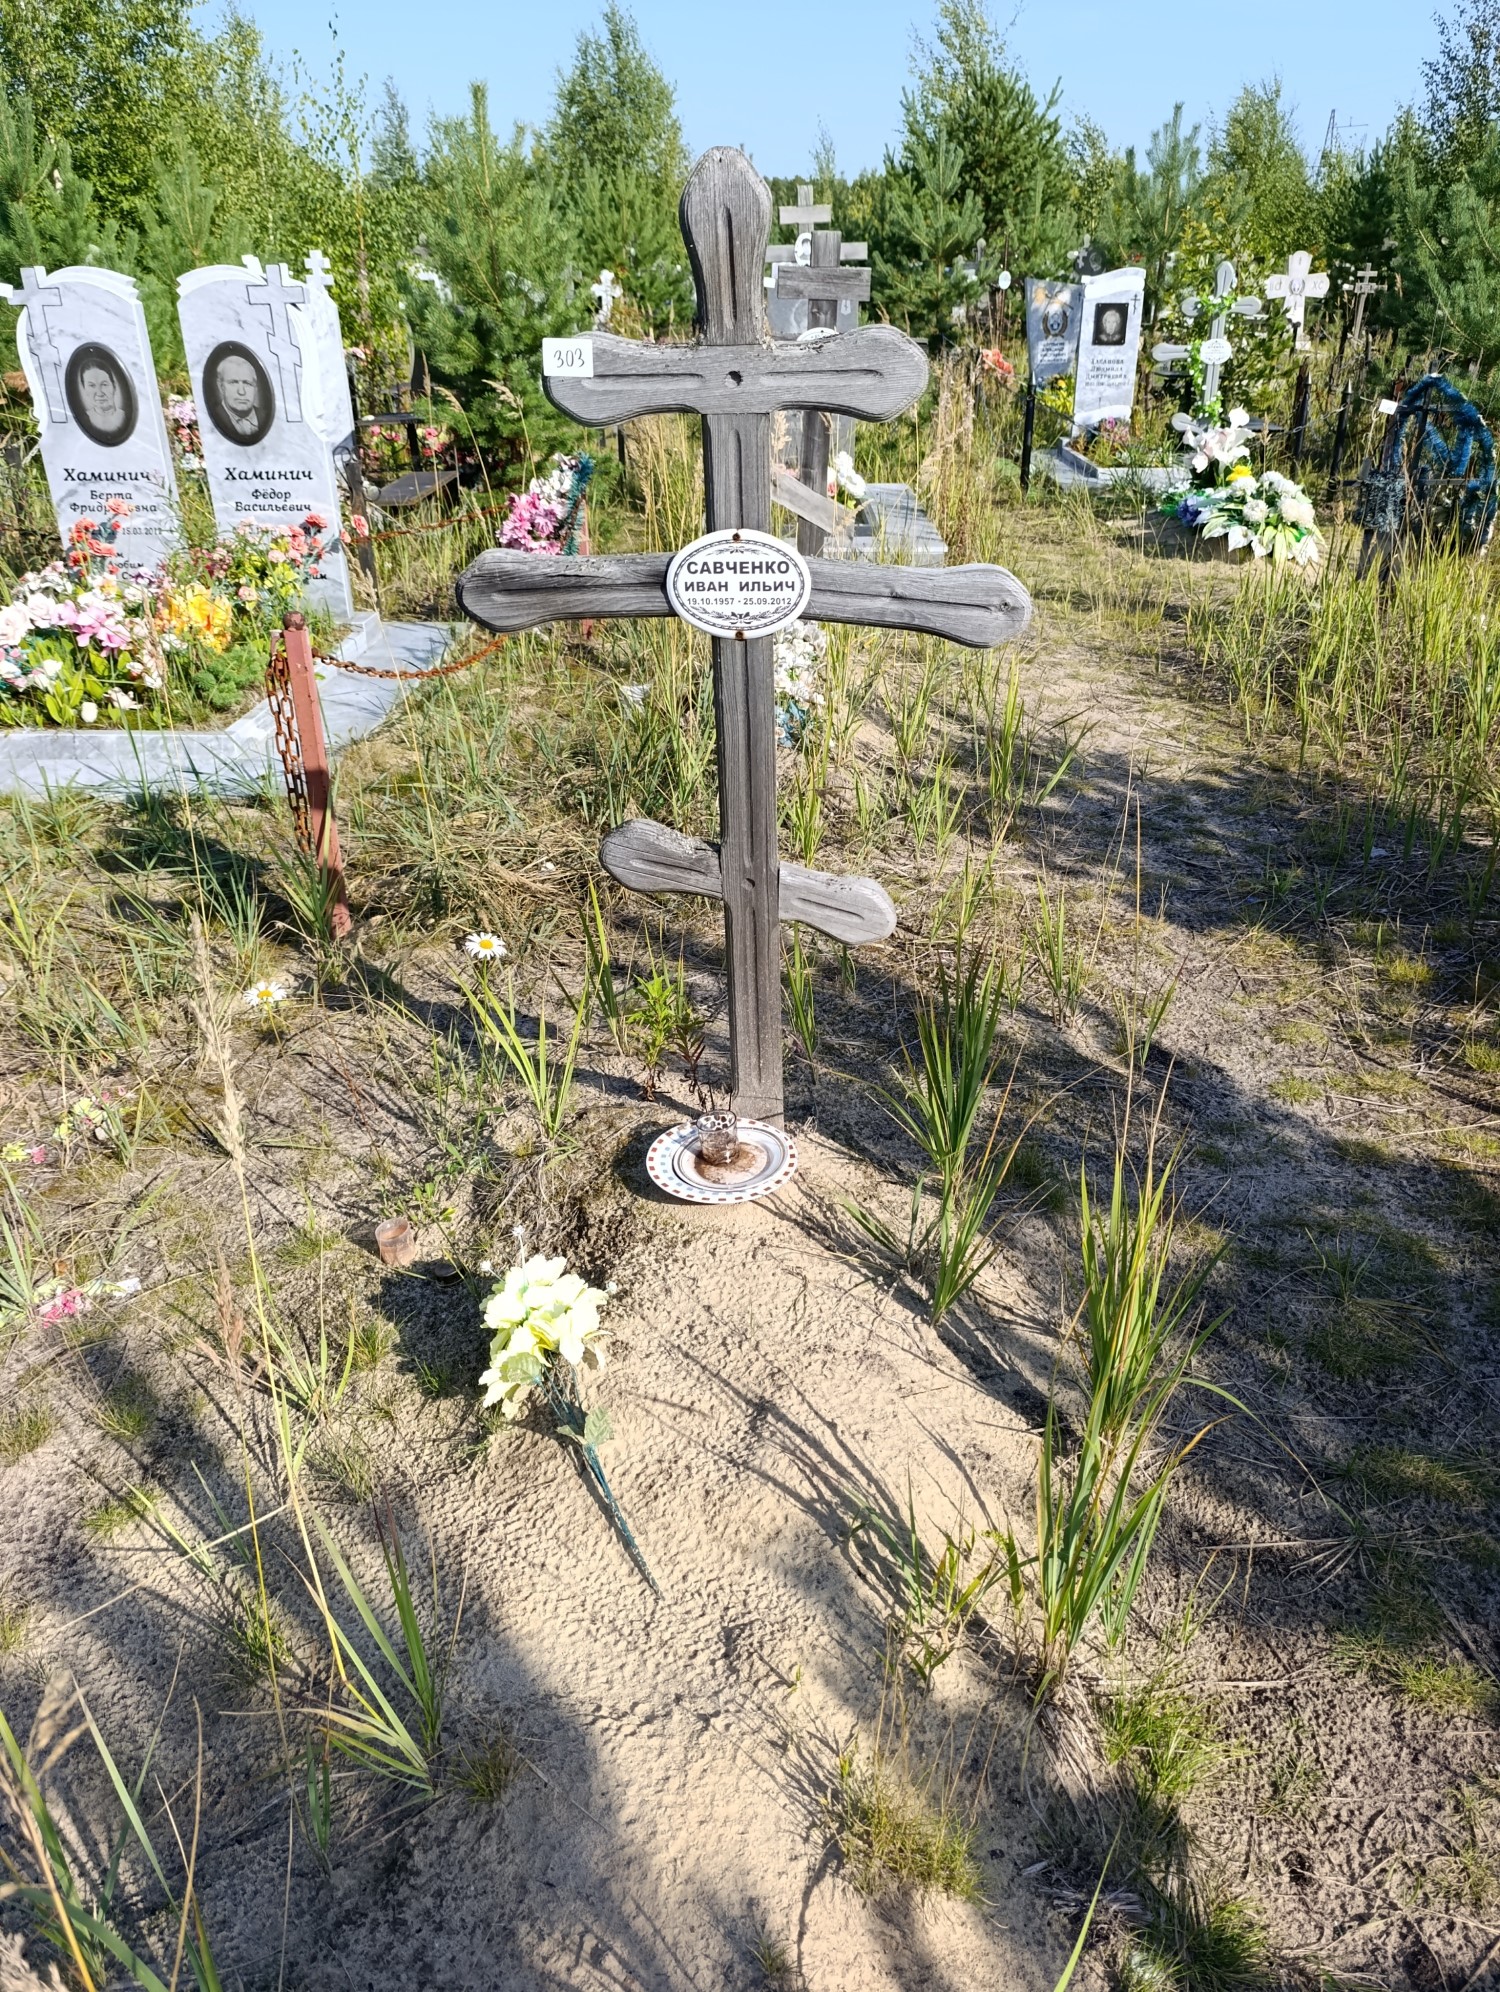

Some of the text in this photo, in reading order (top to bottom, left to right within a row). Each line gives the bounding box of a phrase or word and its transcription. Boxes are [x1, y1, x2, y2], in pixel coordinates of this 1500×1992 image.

[554, 348, 585, 368] 303
[63, 467, 151, 481] Хаминич
[224, 467, 313, 481] Хаминич
[90, 490, 133, 502] Берта
[251, 488, 291, 502] Фёдор
[235, 501, 312, 512] Васильевич
[687, 561, 790, 574] САВЧЕНКО
[684, 581, 795, 592] ИВАН ИЛЬИЧ
